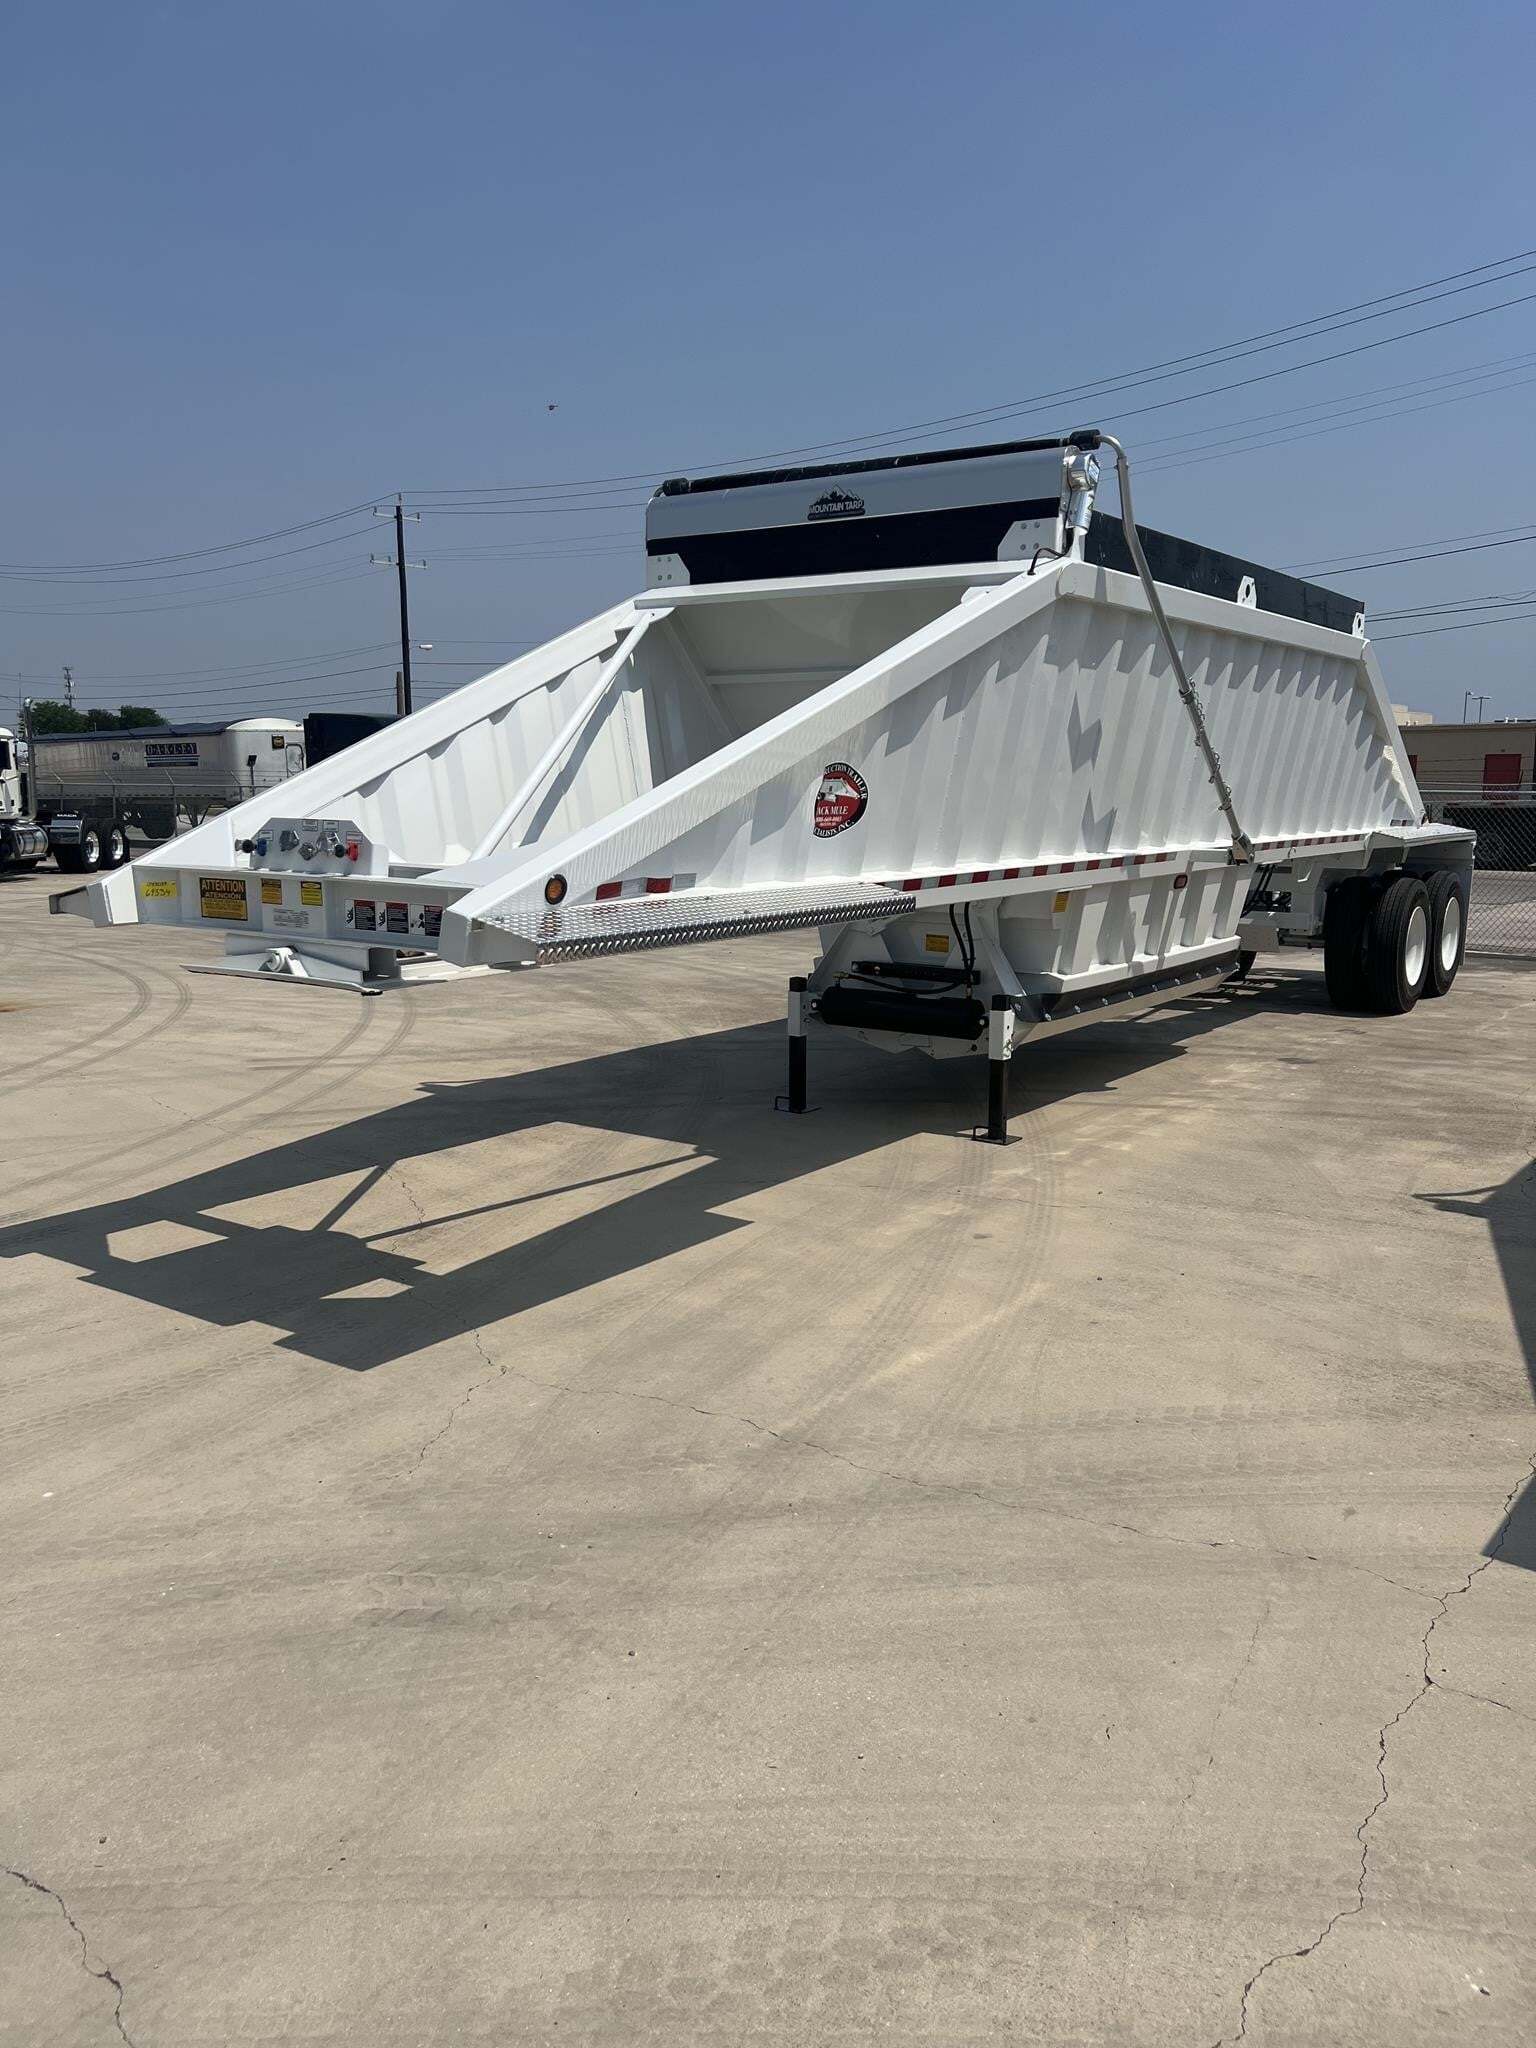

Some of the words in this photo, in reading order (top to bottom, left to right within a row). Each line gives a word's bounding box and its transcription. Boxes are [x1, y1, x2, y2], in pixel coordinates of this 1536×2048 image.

[808, 502, 844, 513] MOUNTAIN
[847, 768, 868, 799] TRAILER
[817, 806, 830, 815] ACK
[831, 805, 848, 815] MULE
[201, 879, 245, 893] ATTENTION
